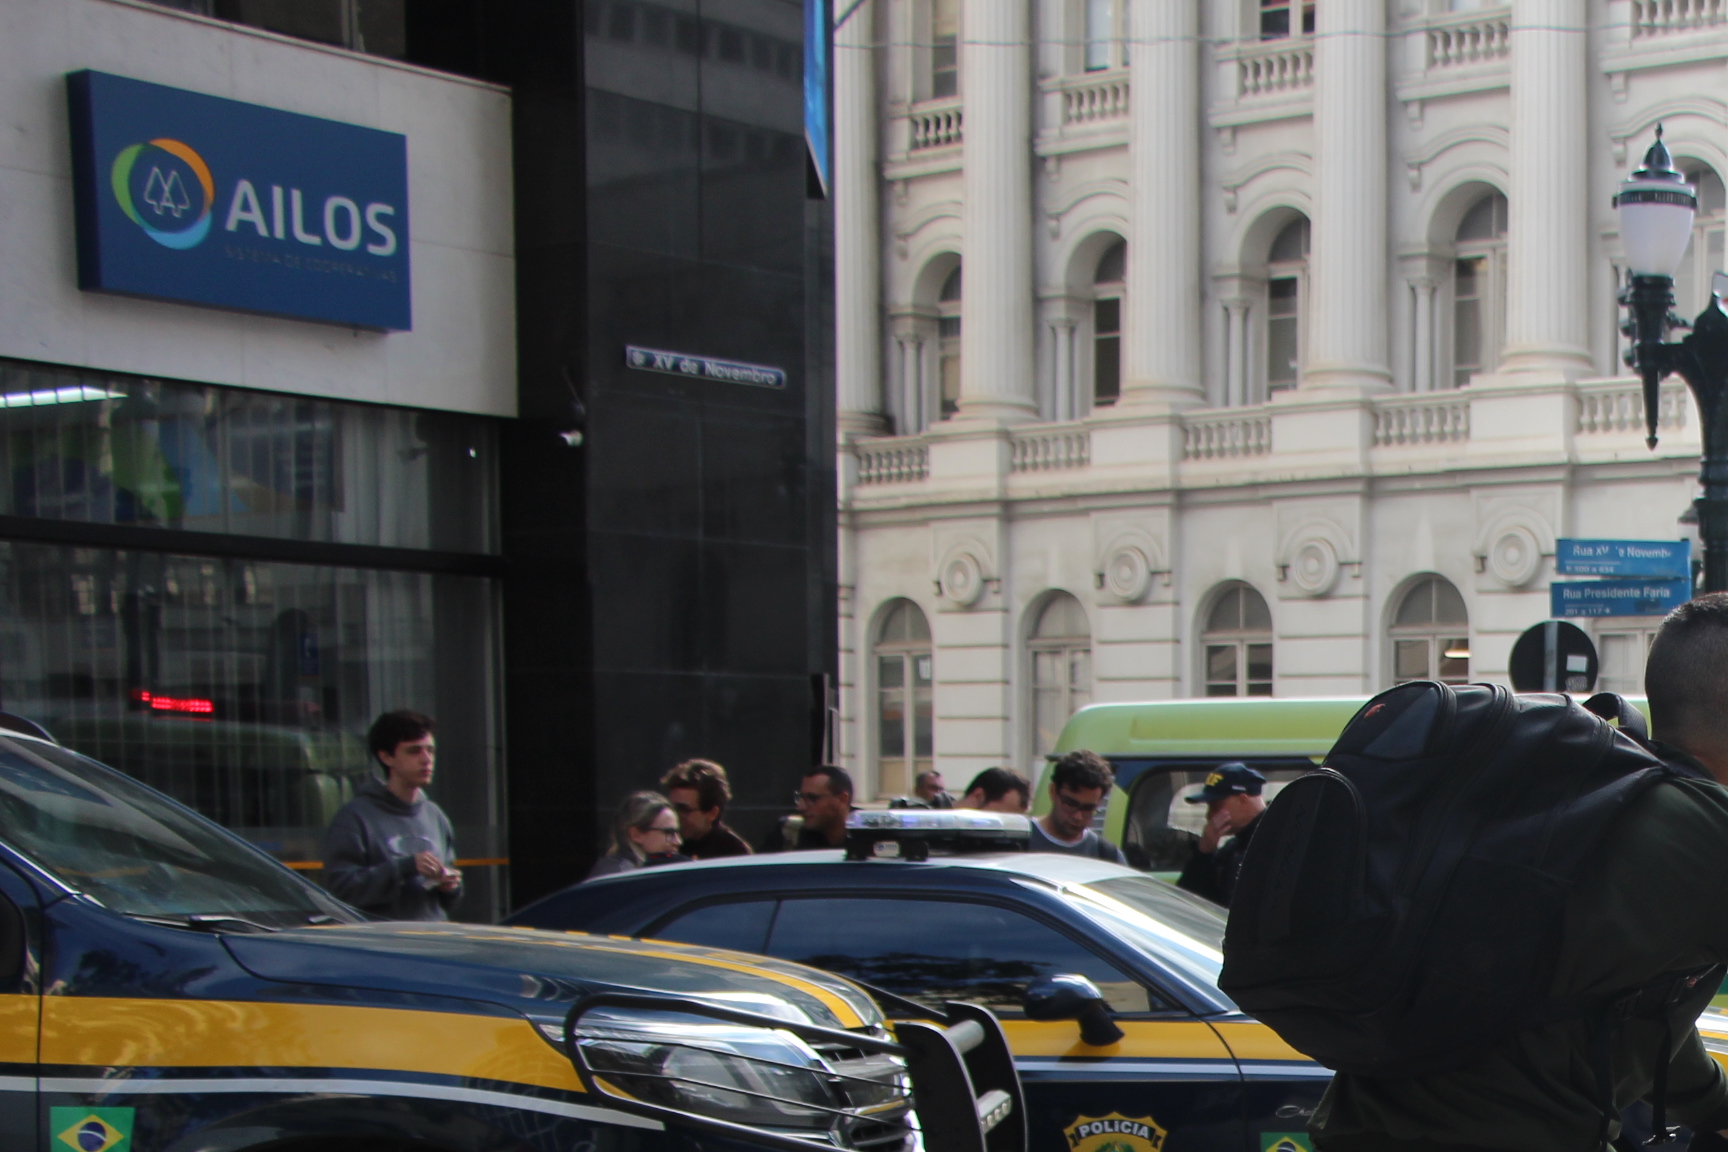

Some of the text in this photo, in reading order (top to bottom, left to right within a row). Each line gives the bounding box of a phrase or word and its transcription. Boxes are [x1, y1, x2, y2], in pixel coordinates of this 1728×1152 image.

[225, 179, 397, 257] AILOS
[653, 353, 777, 385] XV de Novembro
[1573, 545, 1592, 557] Rua
[1563, 587, 1671, 599] Rua Presidente Faria
